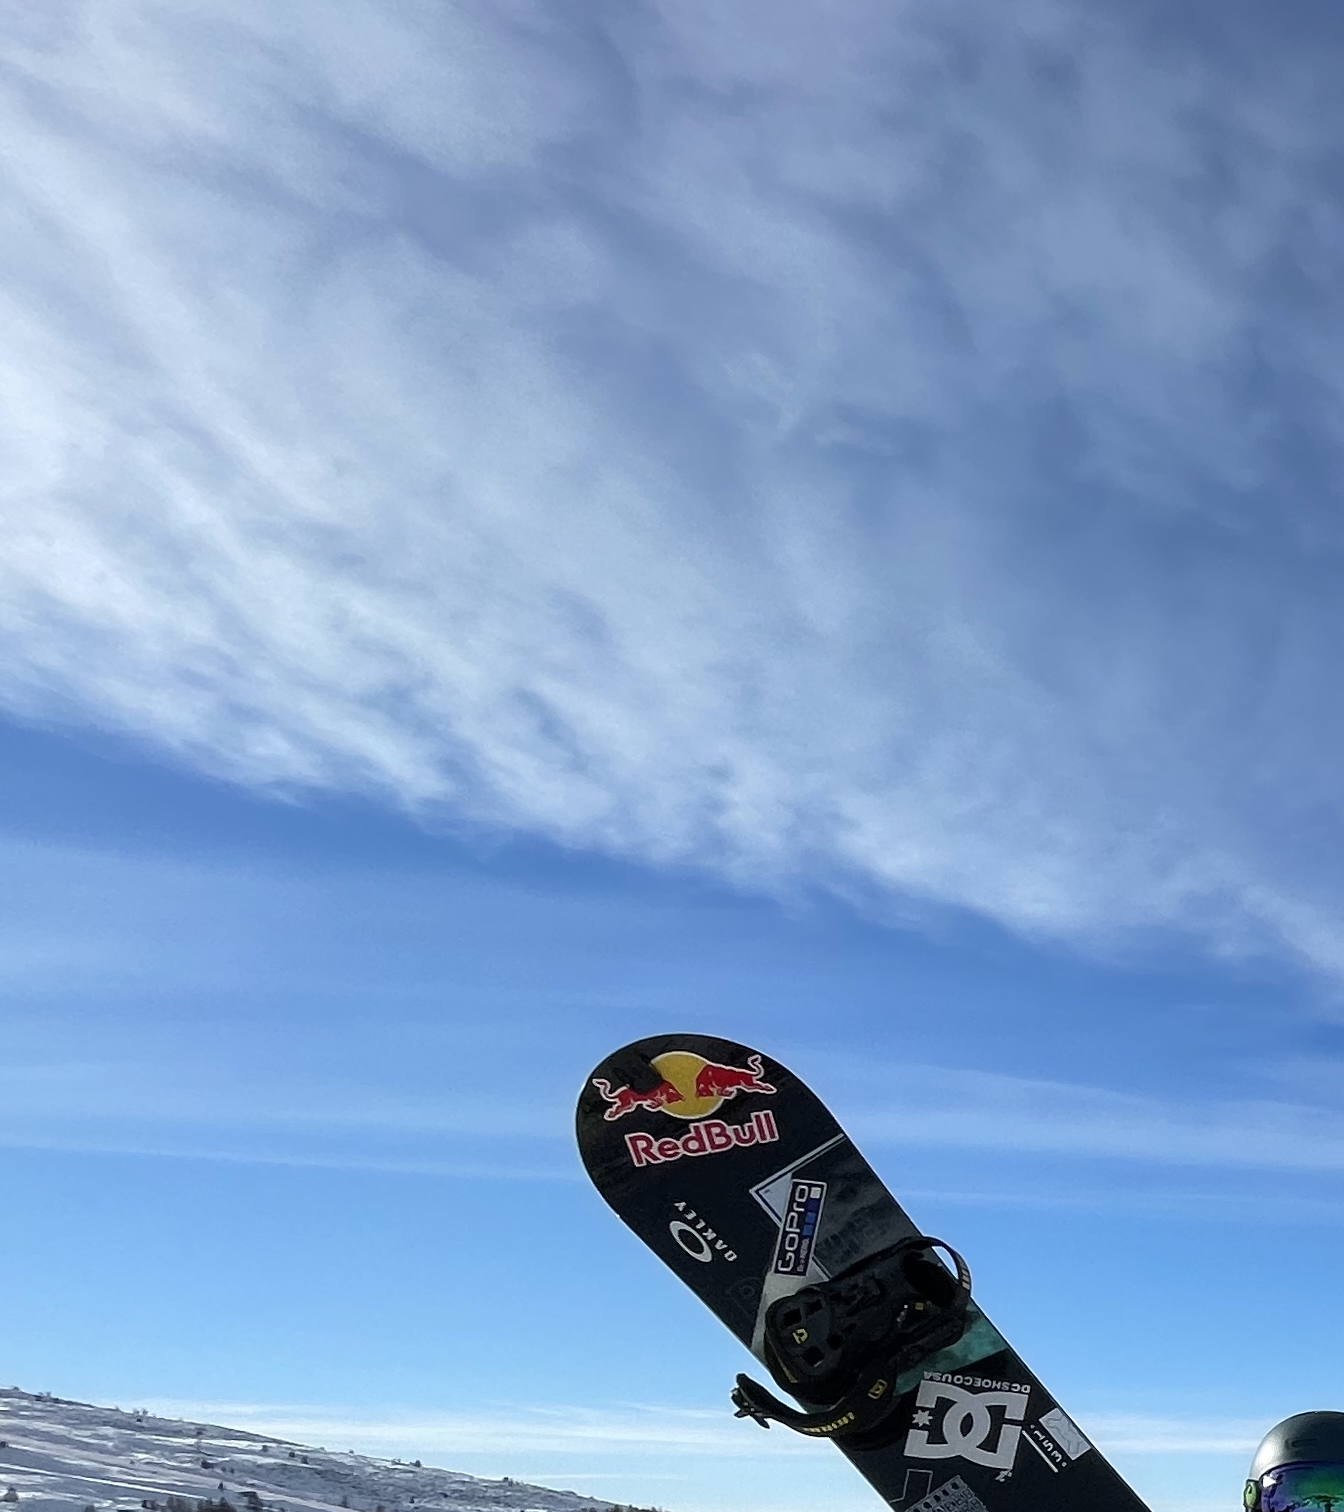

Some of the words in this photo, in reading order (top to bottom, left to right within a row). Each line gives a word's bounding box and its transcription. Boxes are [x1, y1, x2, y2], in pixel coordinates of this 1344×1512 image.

[673, 1200, 738, 1262] OAKLEY
[777, 1184, 809, 1272] GoPro
[922, 1370, 1032, 1394] DCSHOECOUSA
[903, 1379, 1029, 1470] DC
